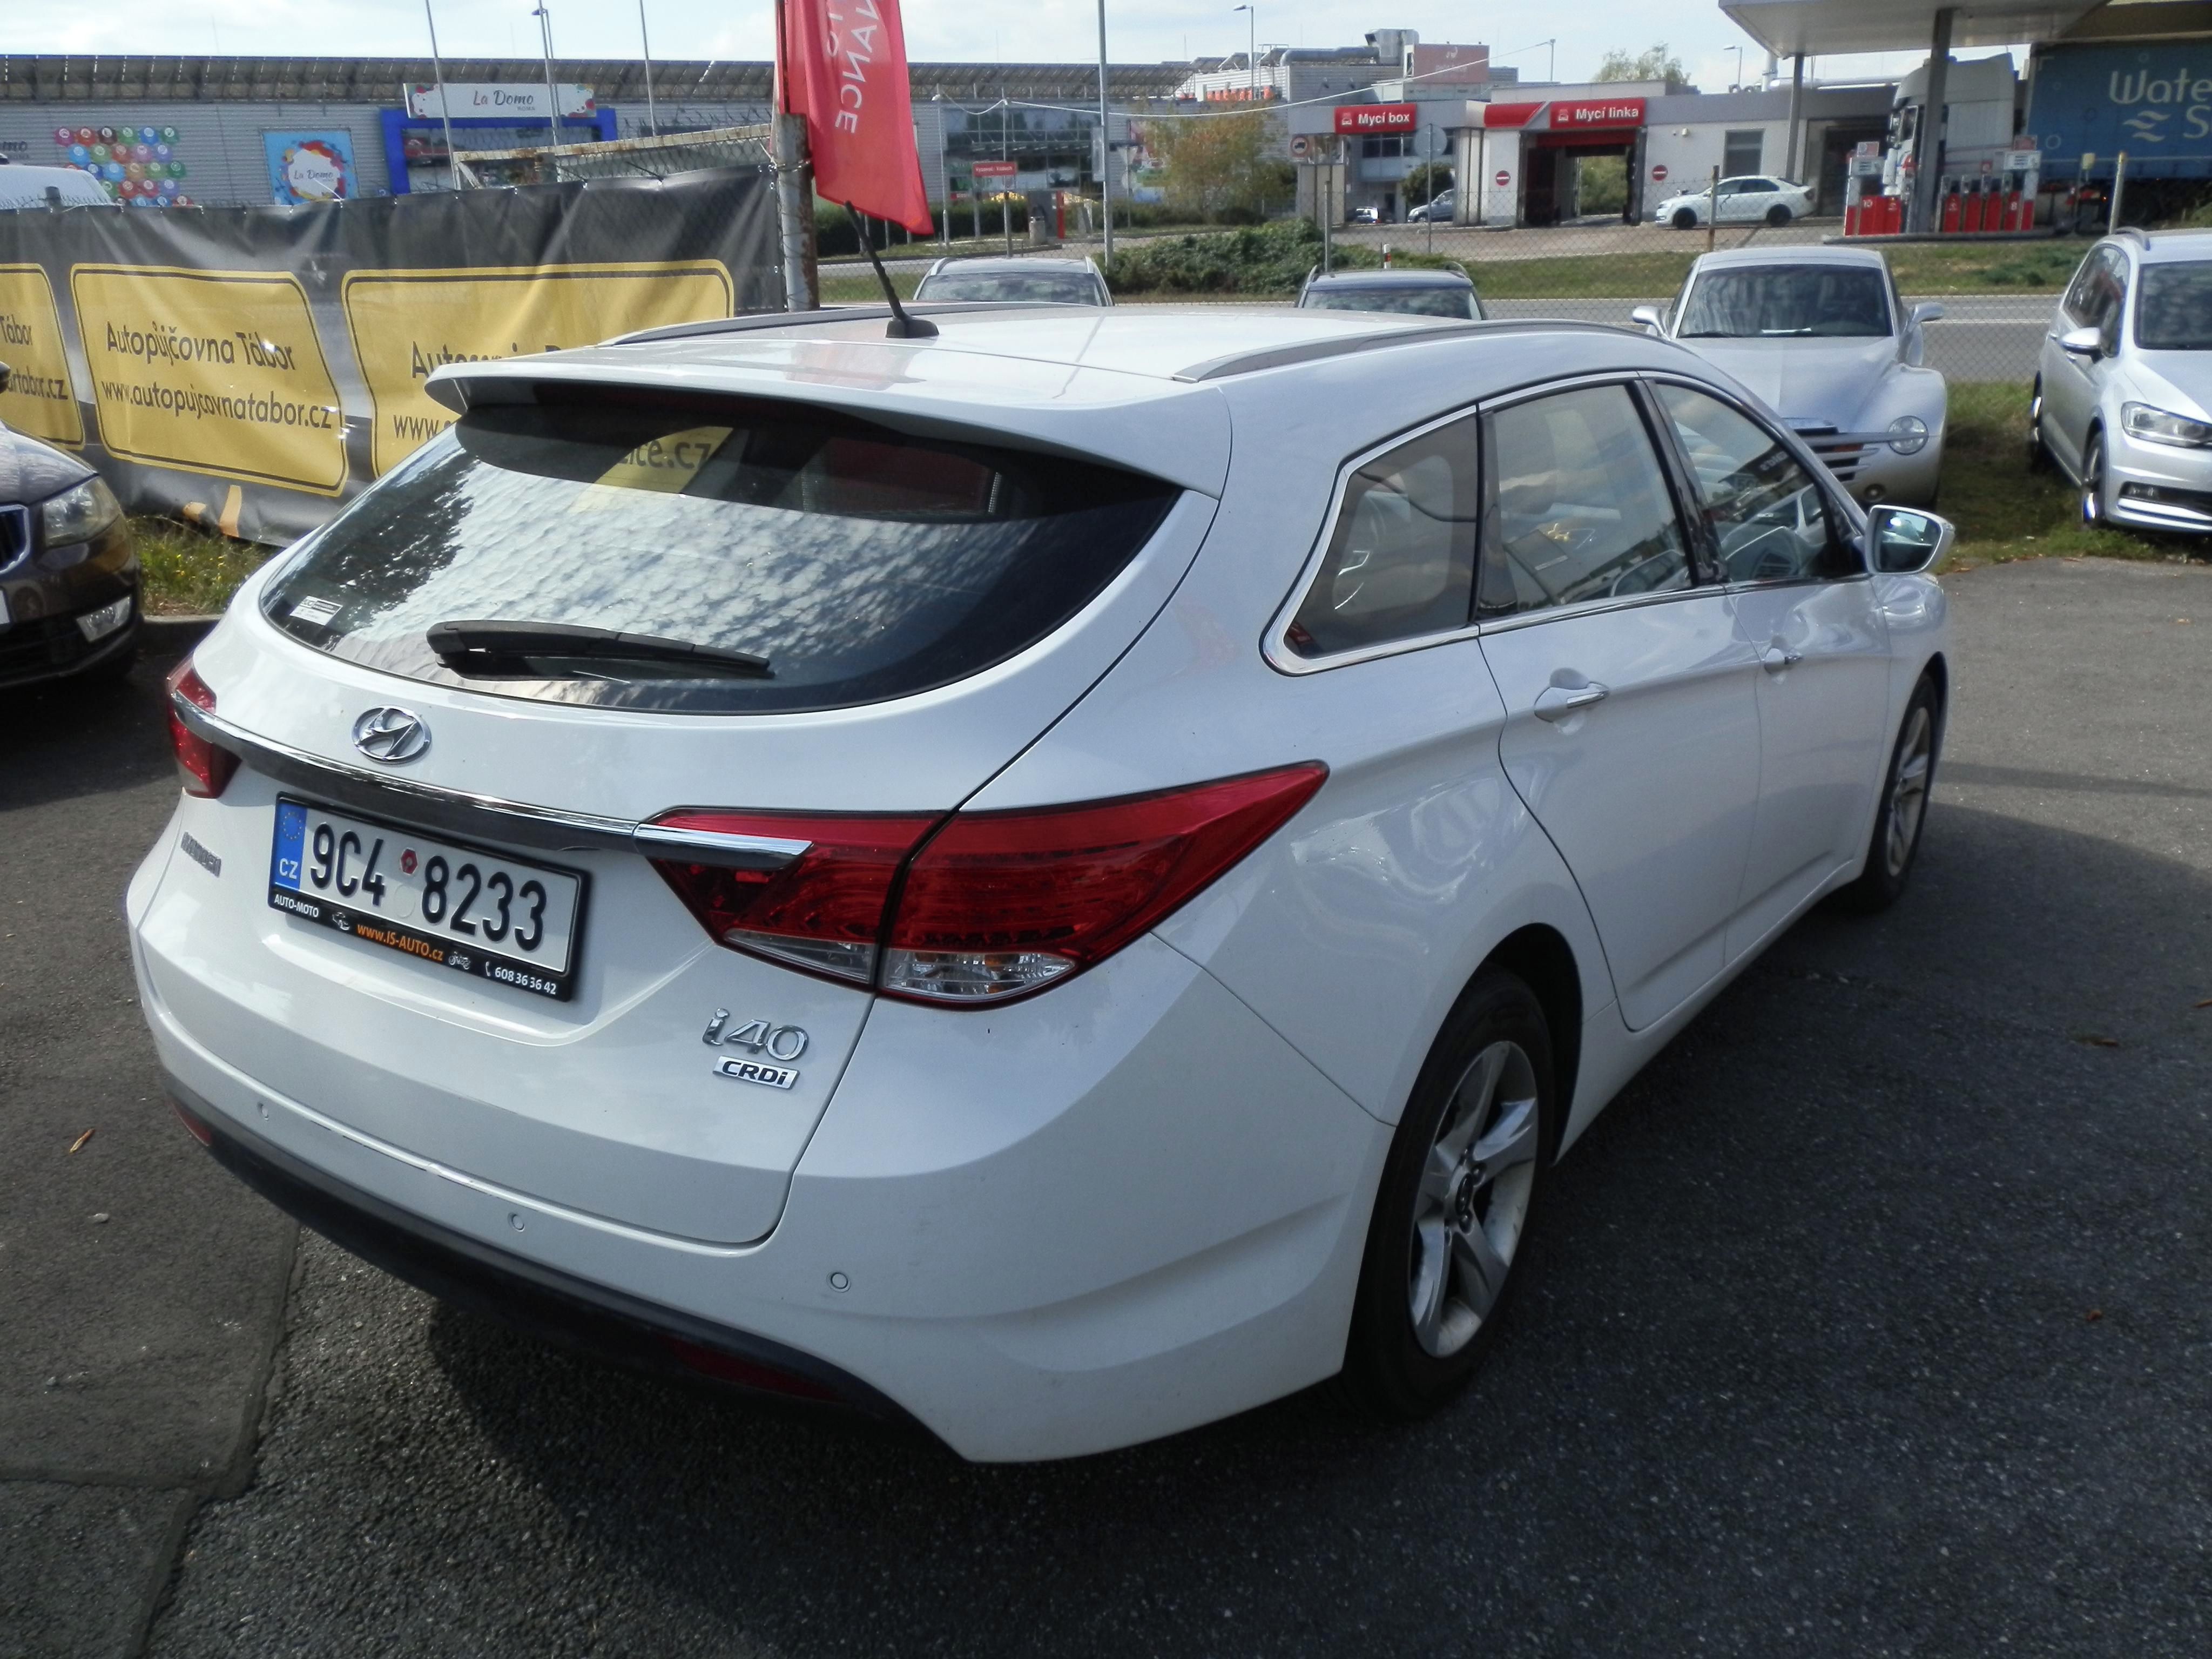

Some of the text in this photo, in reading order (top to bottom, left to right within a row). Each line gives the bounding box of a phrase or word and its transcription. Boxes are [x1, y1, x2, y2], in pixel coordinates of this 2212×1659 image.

[473, 90, 534, 105] La Domo
[1358, 112, 1410, 126] Mycí box
[1576, 107, 1638, 122] Mycí linka
[2183, 105, 2212, 139] S
[294, 168, 333, 179] La Domo
[107, 321, 295, 370] Autopůjčovna Tábor
[101, 381, 332, 429] www.autopujcovnatabor.cz
[279, 858, 298, 879] CZ
[310, 822, 547, 952] 9C4 8233
[274, 894, 319, 918] AUTO-MOTO
[356, 924, 444, 962] www.IS-AUTO.cz
[495, 967, 557, 995] 608 36 36 42
[702, 1007, 809, 1061] i40
[722, 1060, 788, 1085] CRDi
